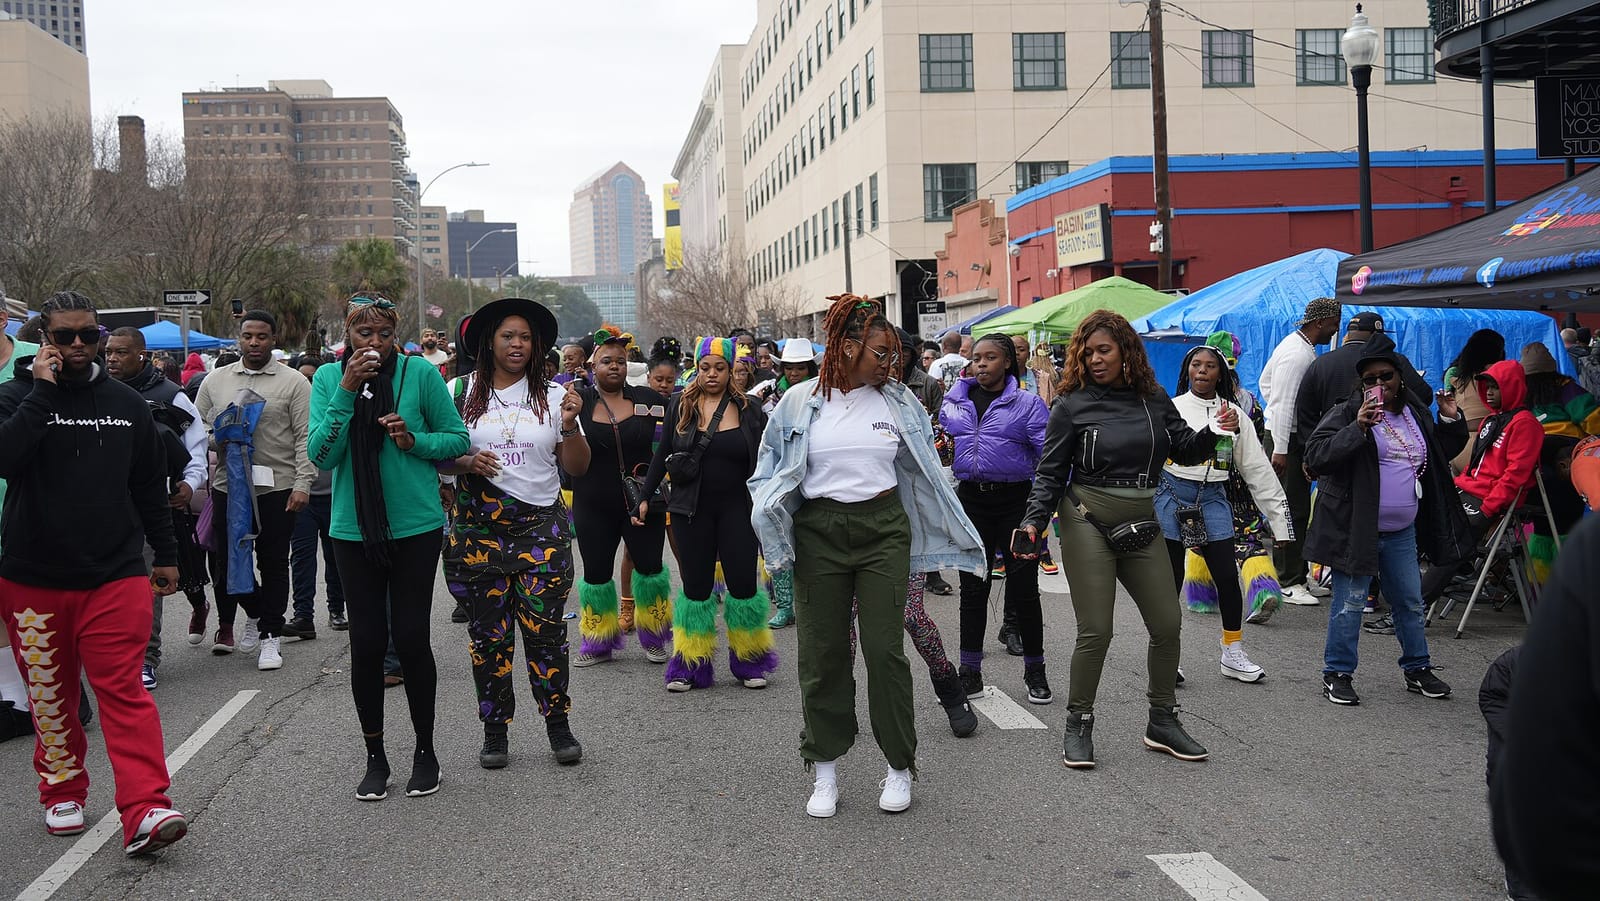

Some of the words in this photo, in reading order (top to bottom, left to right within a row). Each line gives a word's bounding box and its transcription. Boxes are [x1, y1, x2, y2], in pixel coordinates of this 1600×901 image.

[1564, 117, 1600, 135] YOG
[1057, 213, 1084, 237] BASIN
[1058, 235, 1081, 256] SEAFOOD
[1087, 231, 1102, 250] GRILL
[316, 444, 331, 463] THE
[325, 417, 344, 444] WAY
[519, 441, 534, 449] into
[502, 450, 526, 467] 30!
